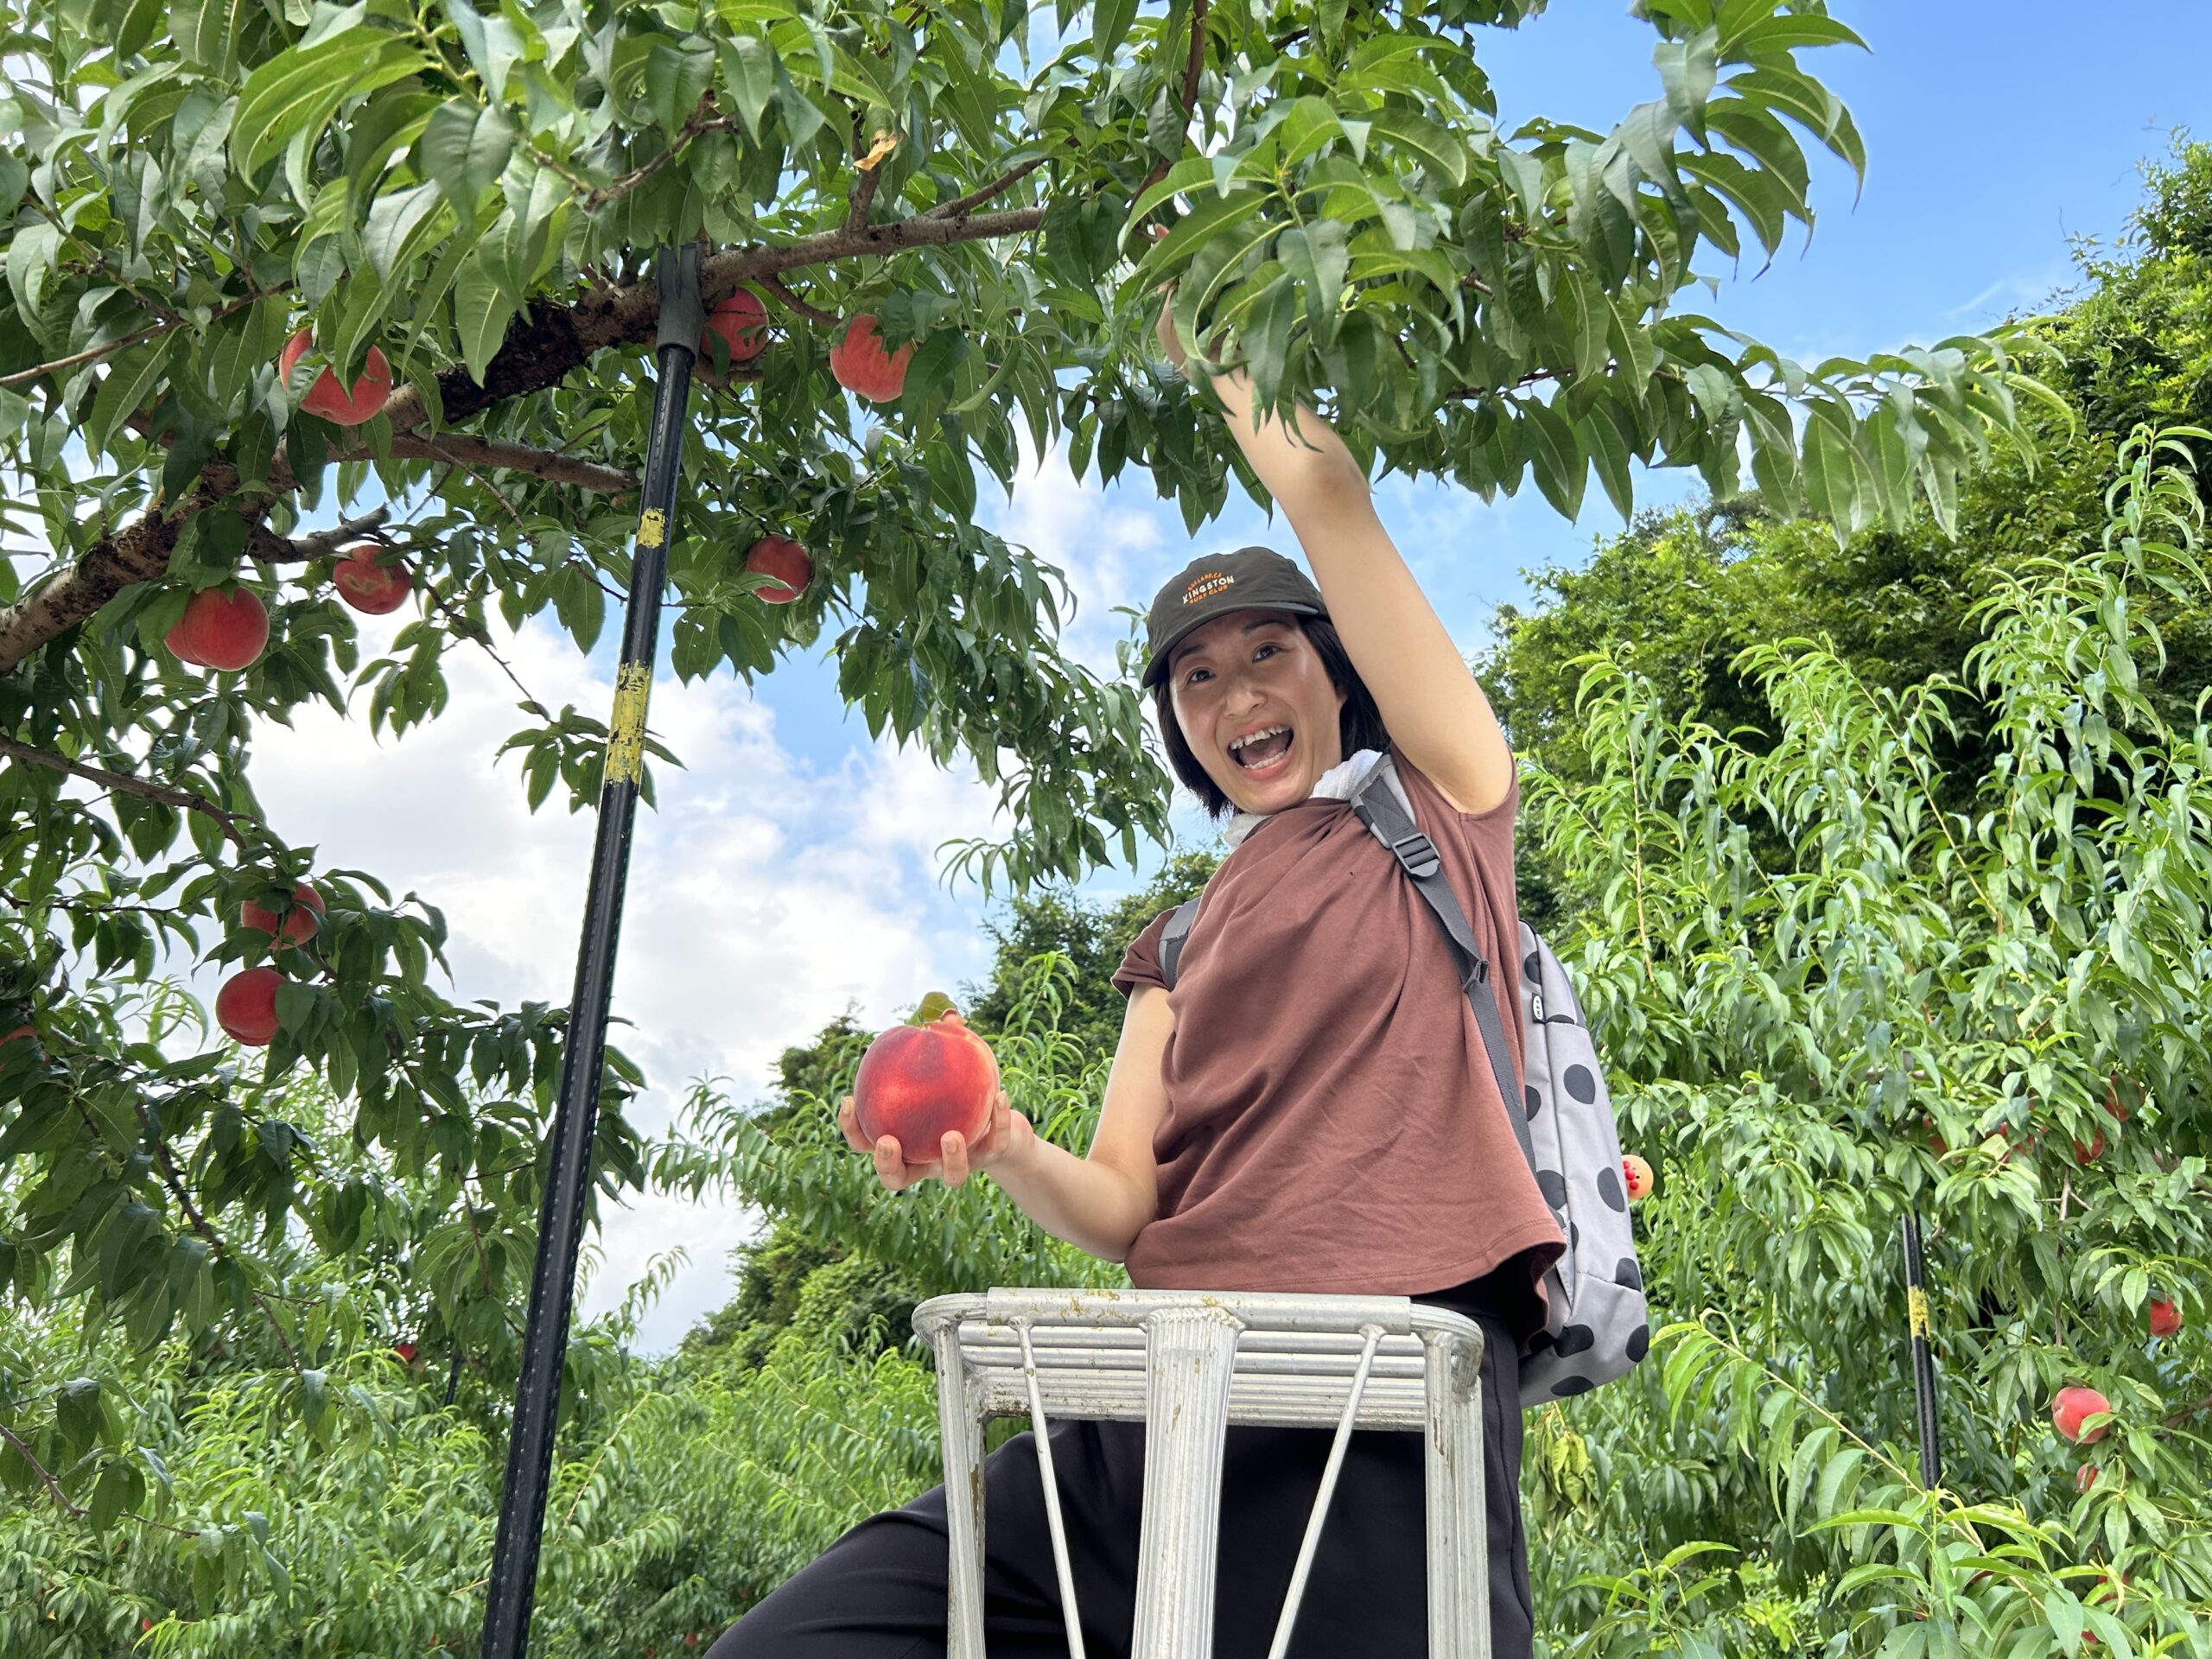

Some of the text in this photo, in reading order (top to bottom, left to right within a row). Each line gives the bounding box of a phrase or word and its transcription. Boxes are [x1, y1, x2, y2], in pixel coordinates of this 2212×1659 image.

[1182, 575, 1235, 605] KINGSTON
[1189, 584, 1228, 604] SURF CLUB
